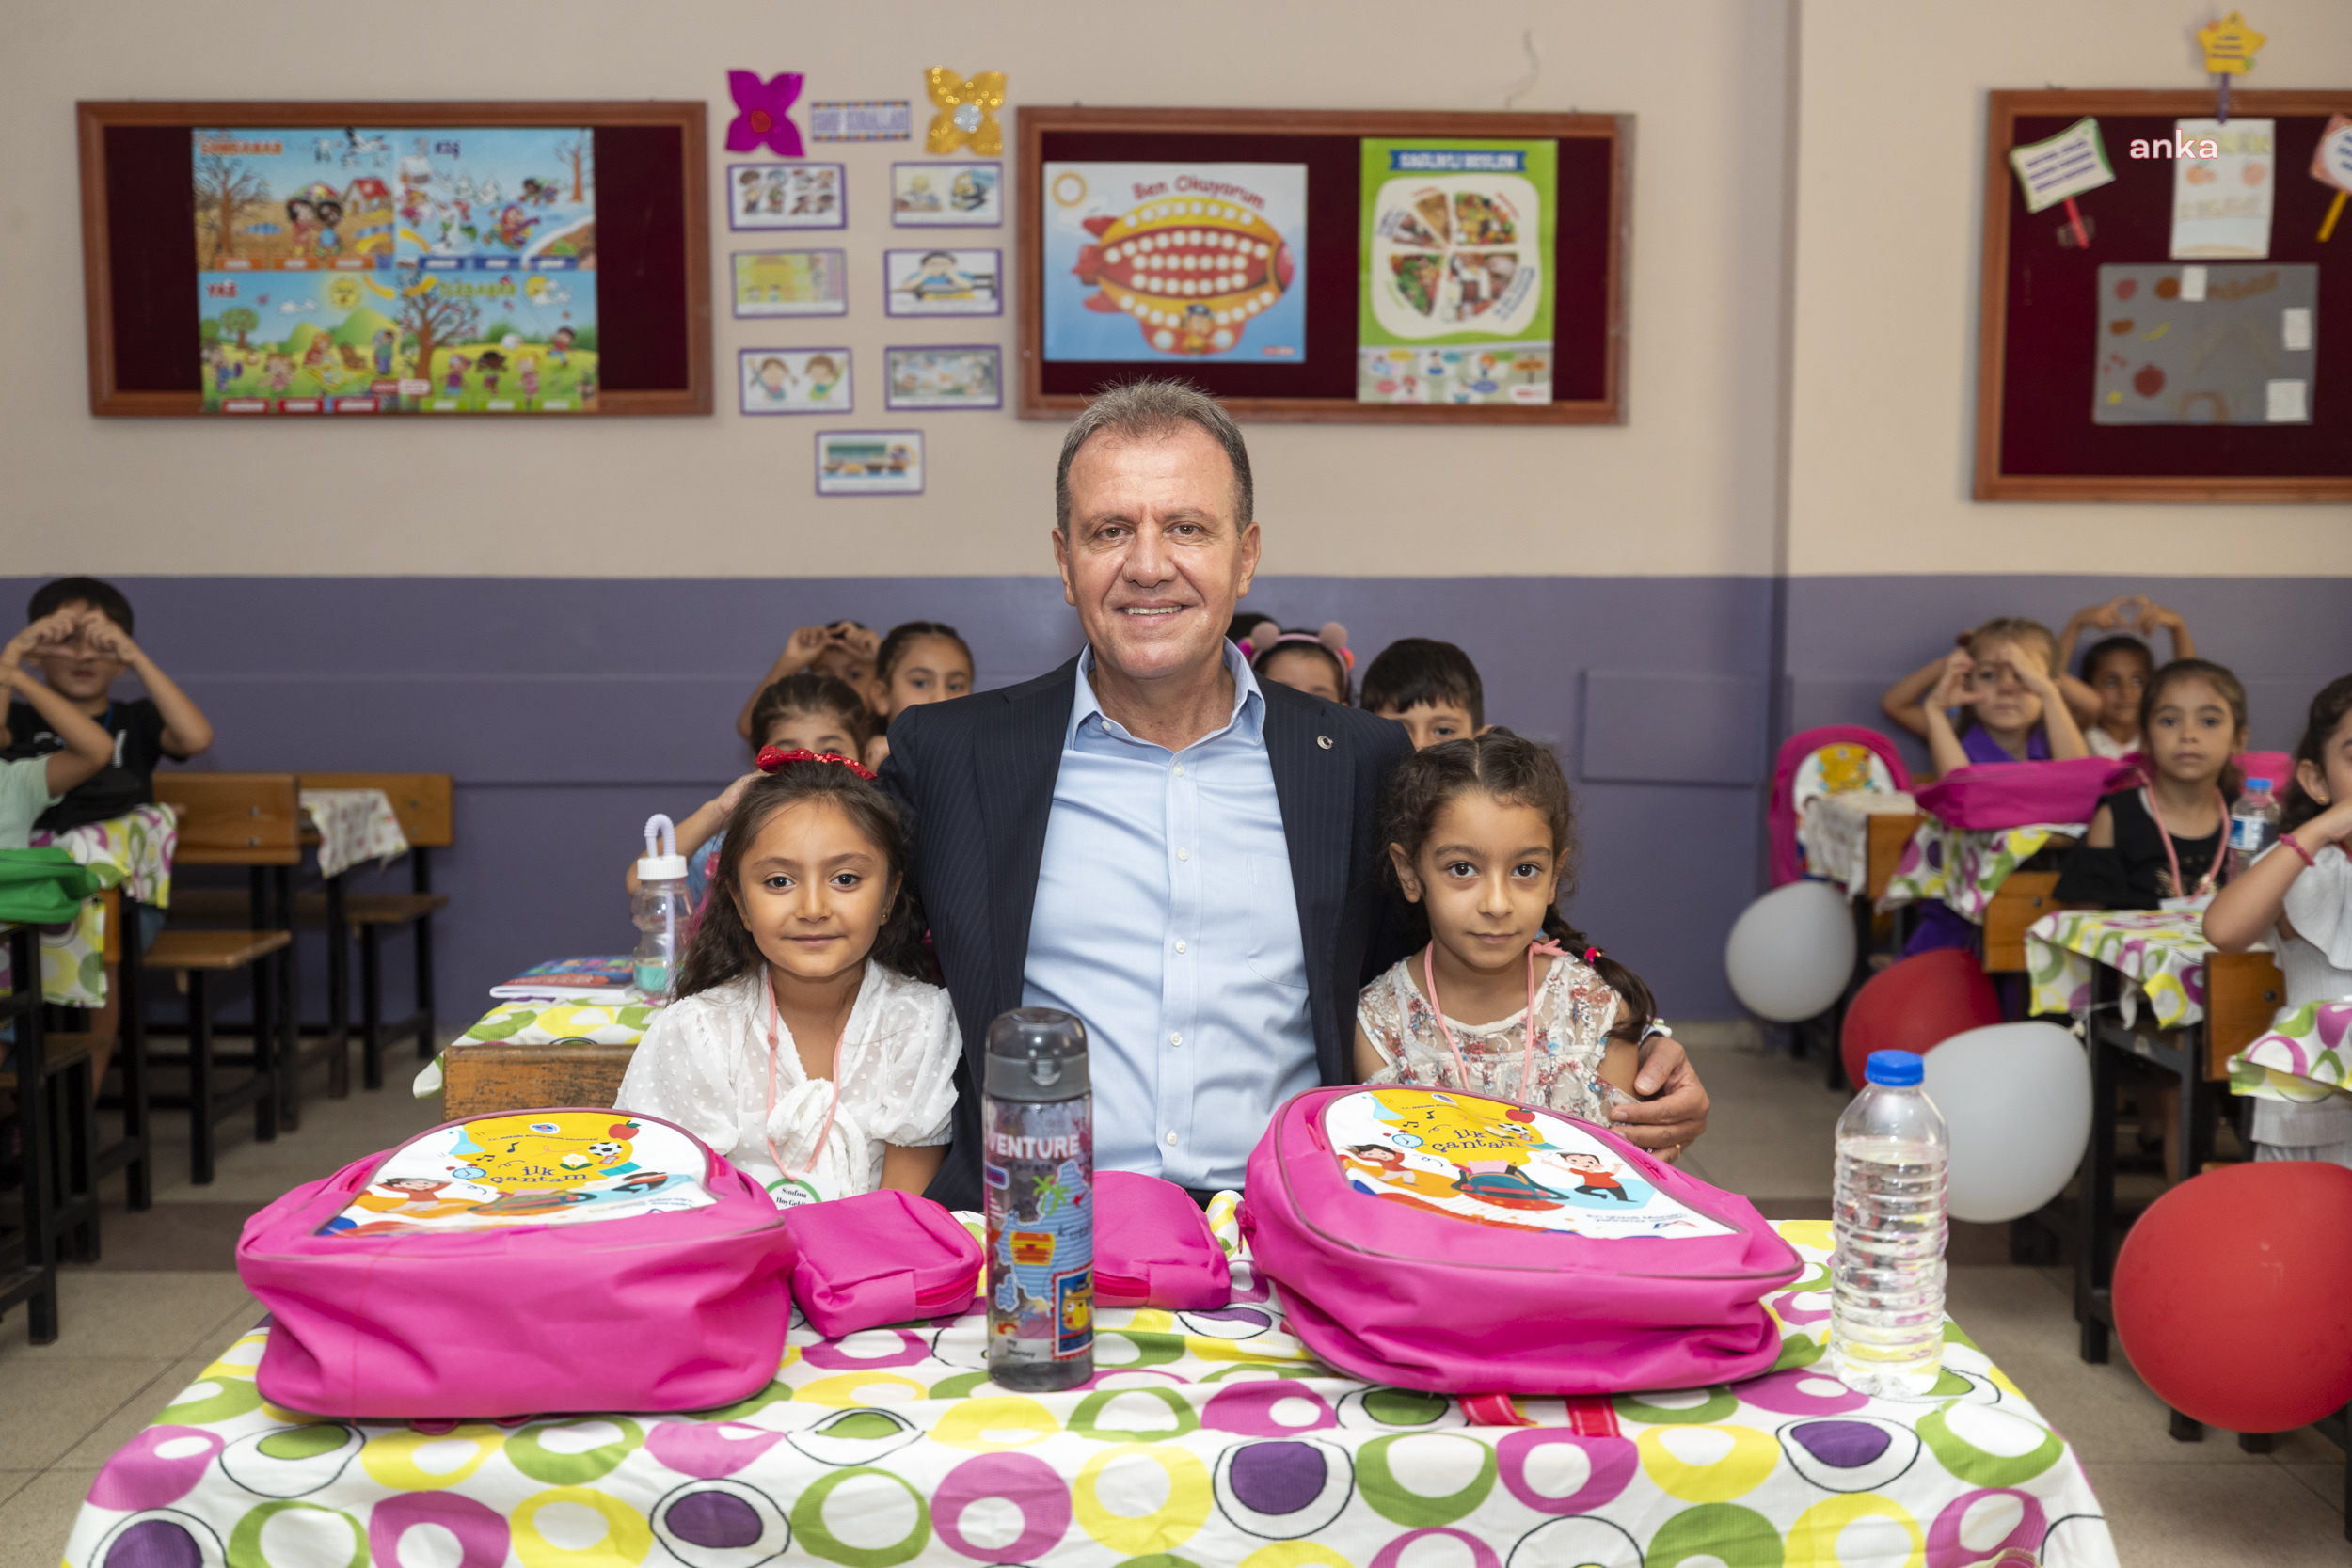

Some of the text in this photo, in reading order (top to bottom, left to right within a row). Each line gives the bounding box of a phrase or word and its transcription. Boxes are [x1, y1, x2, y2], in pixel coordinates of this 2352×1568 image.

[1132, 173, 1266, 211] Ben Okuyorum
[1454, 1129, 1487, 1139] ilk
[1432, 1138, 1521, 1153] çantam
[522, 1165, 555, 1176] ilk
[489, 1173, 588, 1183] çantam
